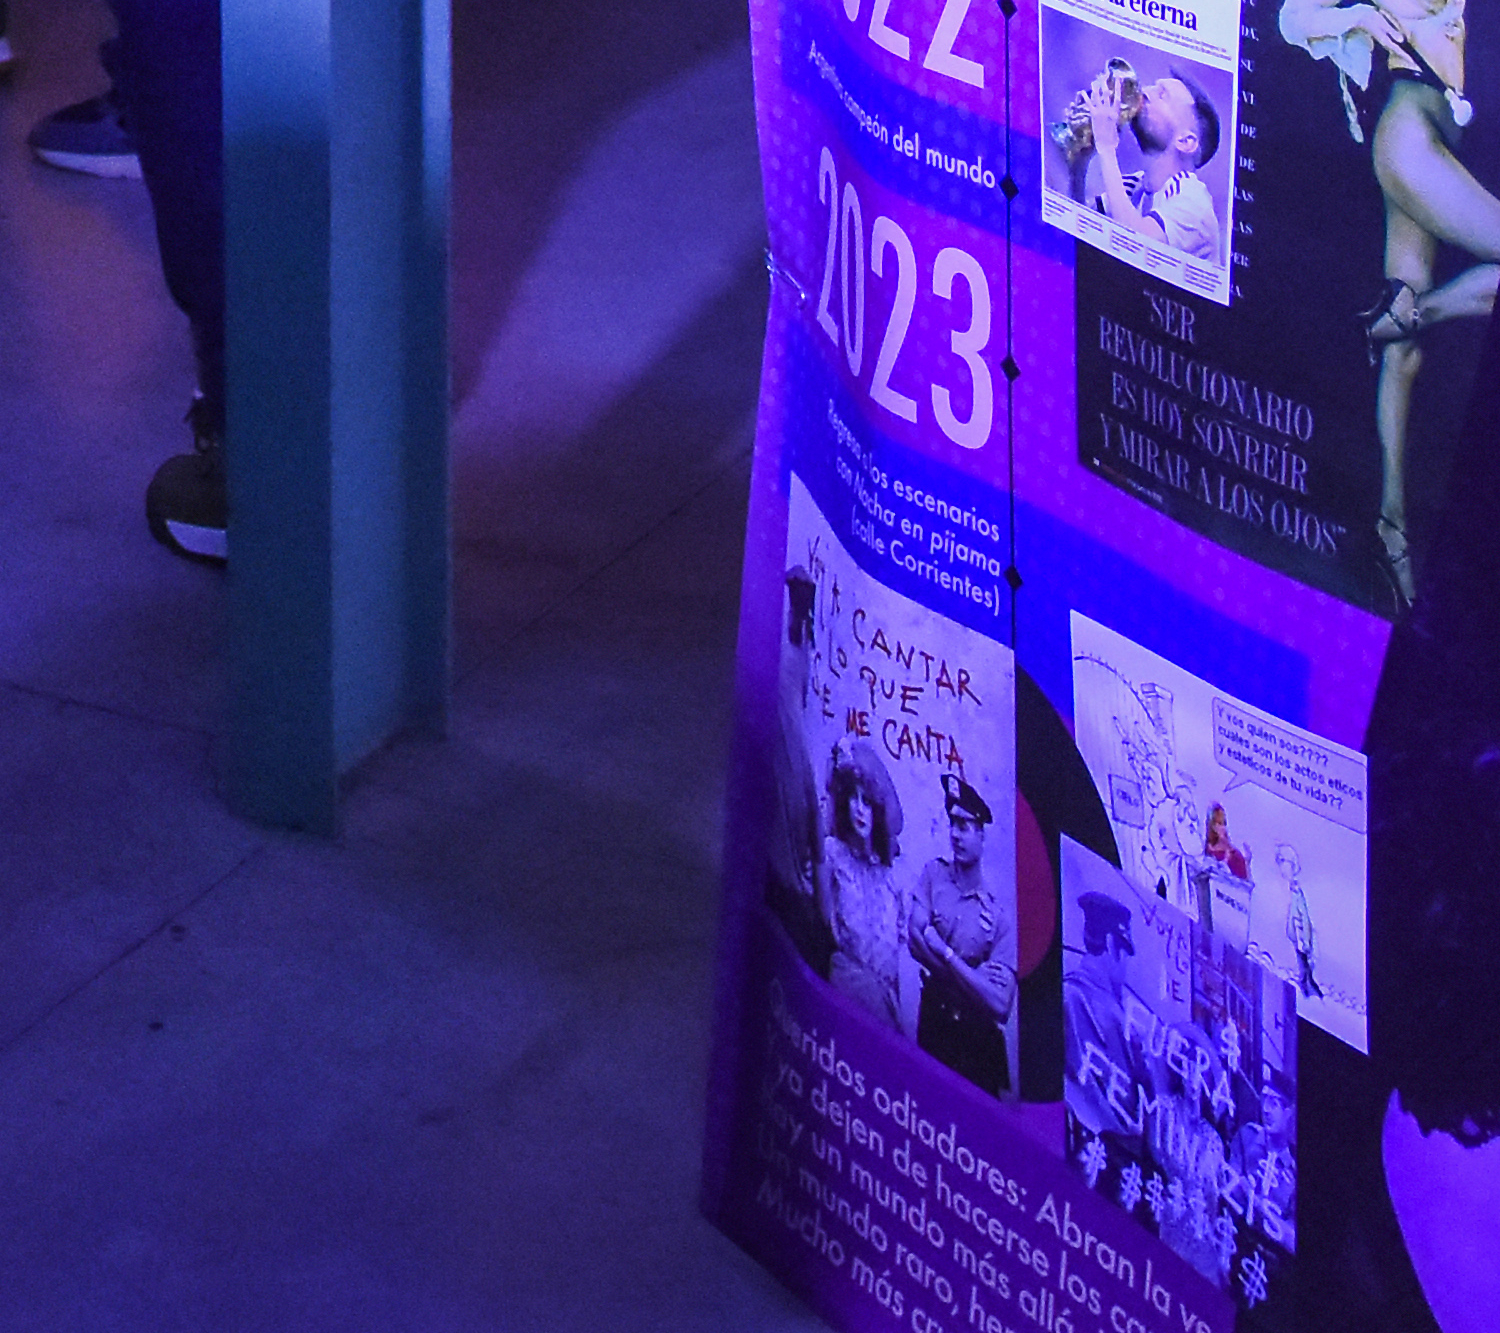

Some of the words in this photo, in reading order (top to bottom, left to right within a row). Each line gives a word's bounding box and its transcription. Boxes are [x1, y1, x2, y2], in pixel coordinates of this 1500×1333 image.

[893, 124, 919, 161] del
[925, 146, 996, 189] mundo
[816, 146, 994, 450] 2023
[1099, 315, 1314, 442] REVOLUCIONARIO
[1111, 370, 1138, 413] ES
[1142, 385, 1187, 441] HOY
[1118, 423, 1190, 493] MIRAR
[1217, 474, 1265, 528] LOS
[890, 537, 1000, 618] Corrientes)
[900, 514, 923, 542] en
[930, 527, 1000, 579] pijama
[851, 607, 983, 707] CANTAR
[881, 718, 968, 783] CANTA
[1252, 743, 1273, 760] son
[1274, 751, 1291, 769] los
[1294, 762, 1325, 785] actos
[810, 1080, 883, 1159] dejen
[892, 1139, 928, 1190] de
[935, 1171, 1051, 1279] hacerse
[1058, 1248, 1101, 1316] los
[873, 1090, 1028, 1214] odiadores:
[1036, 1191, 1136, 1289] Abran
[1144, 1258, 1172, 1314] la
